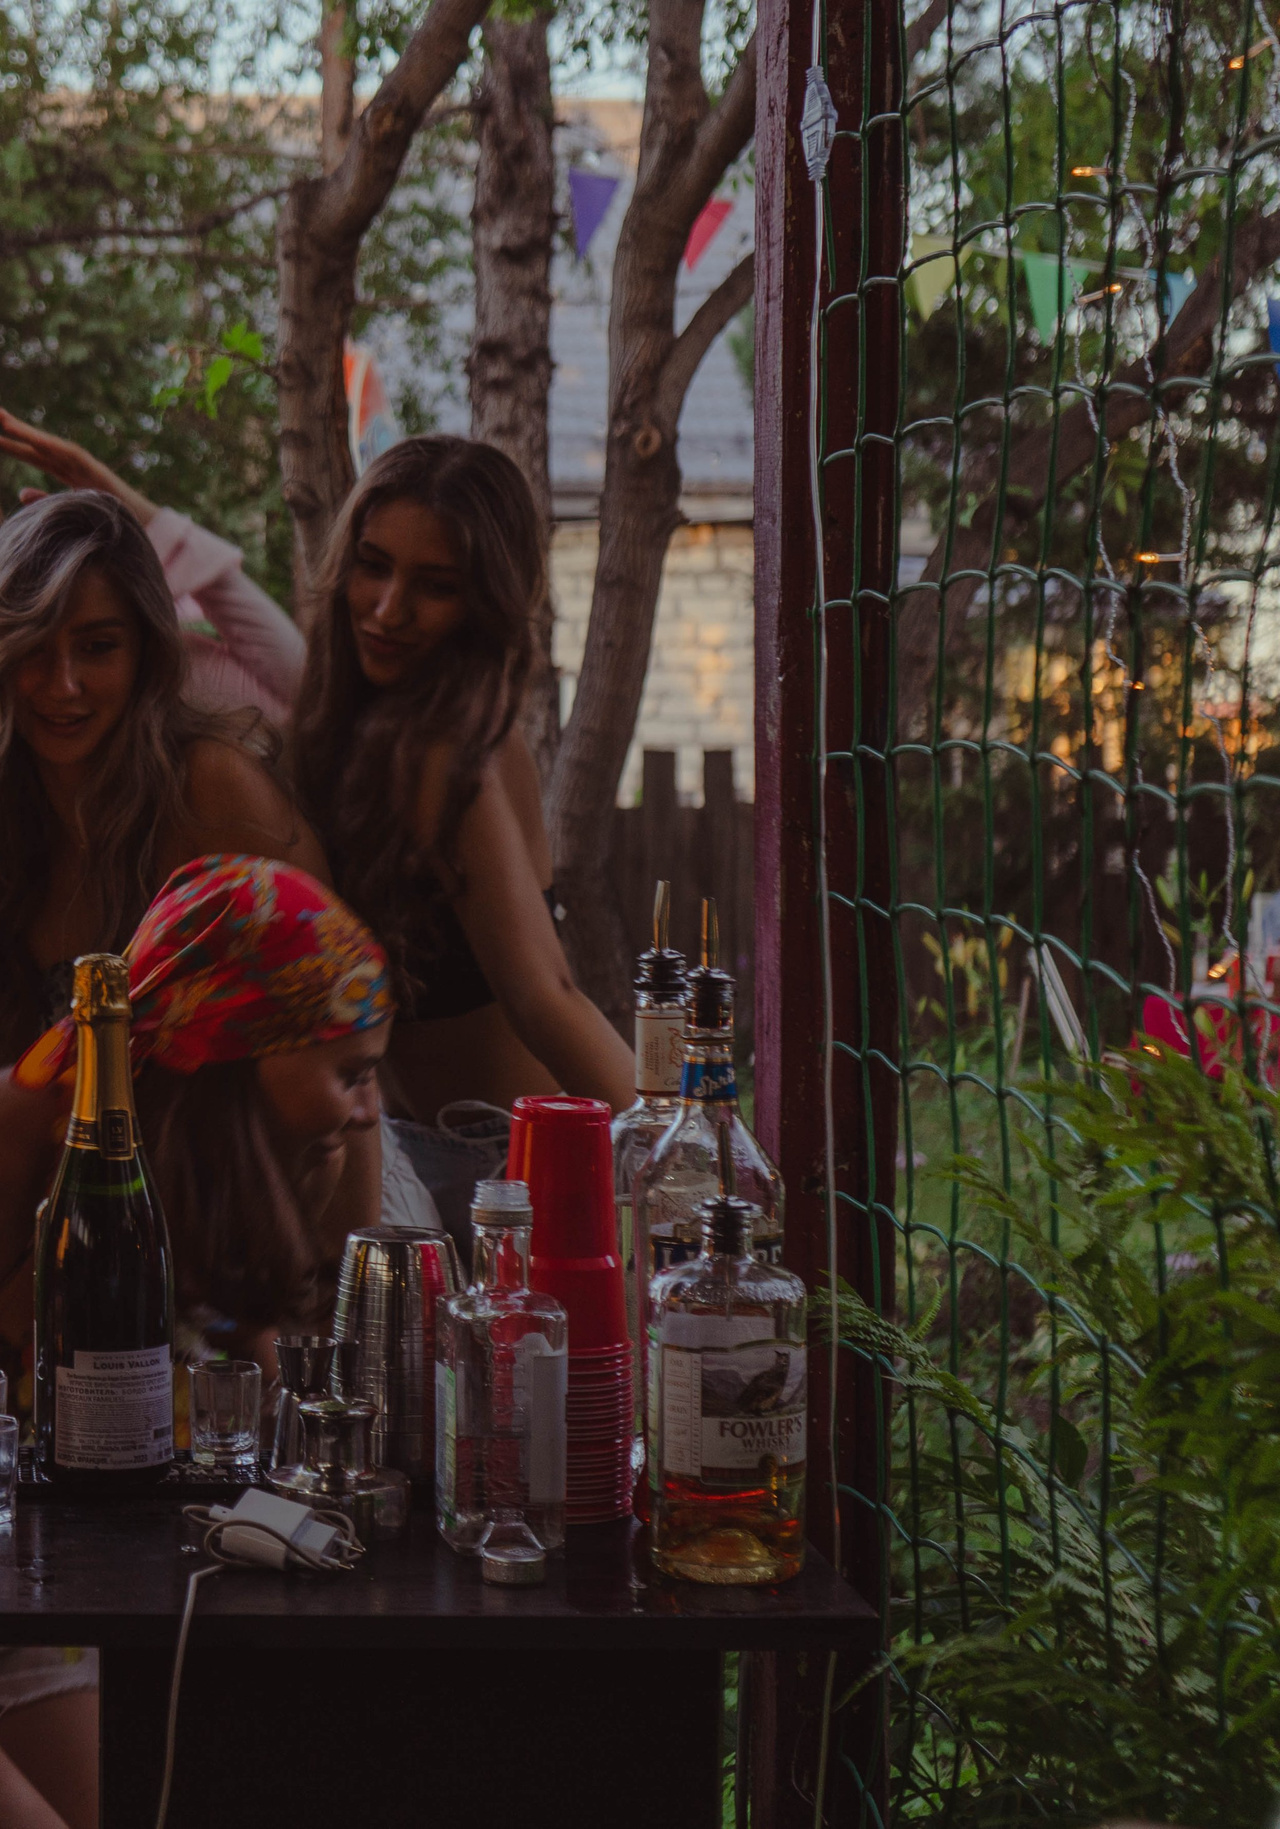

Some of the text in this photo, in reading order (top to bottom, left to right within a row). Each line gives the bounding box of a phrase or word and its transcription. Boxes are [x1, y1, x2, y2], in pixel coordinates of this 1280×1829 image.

[93, 1358, 161, 1370] LOUIS VALLON
[720, 1415, 802, 1438] FOWLER'S
[742, 1436, 790, 1449] WHISKY
